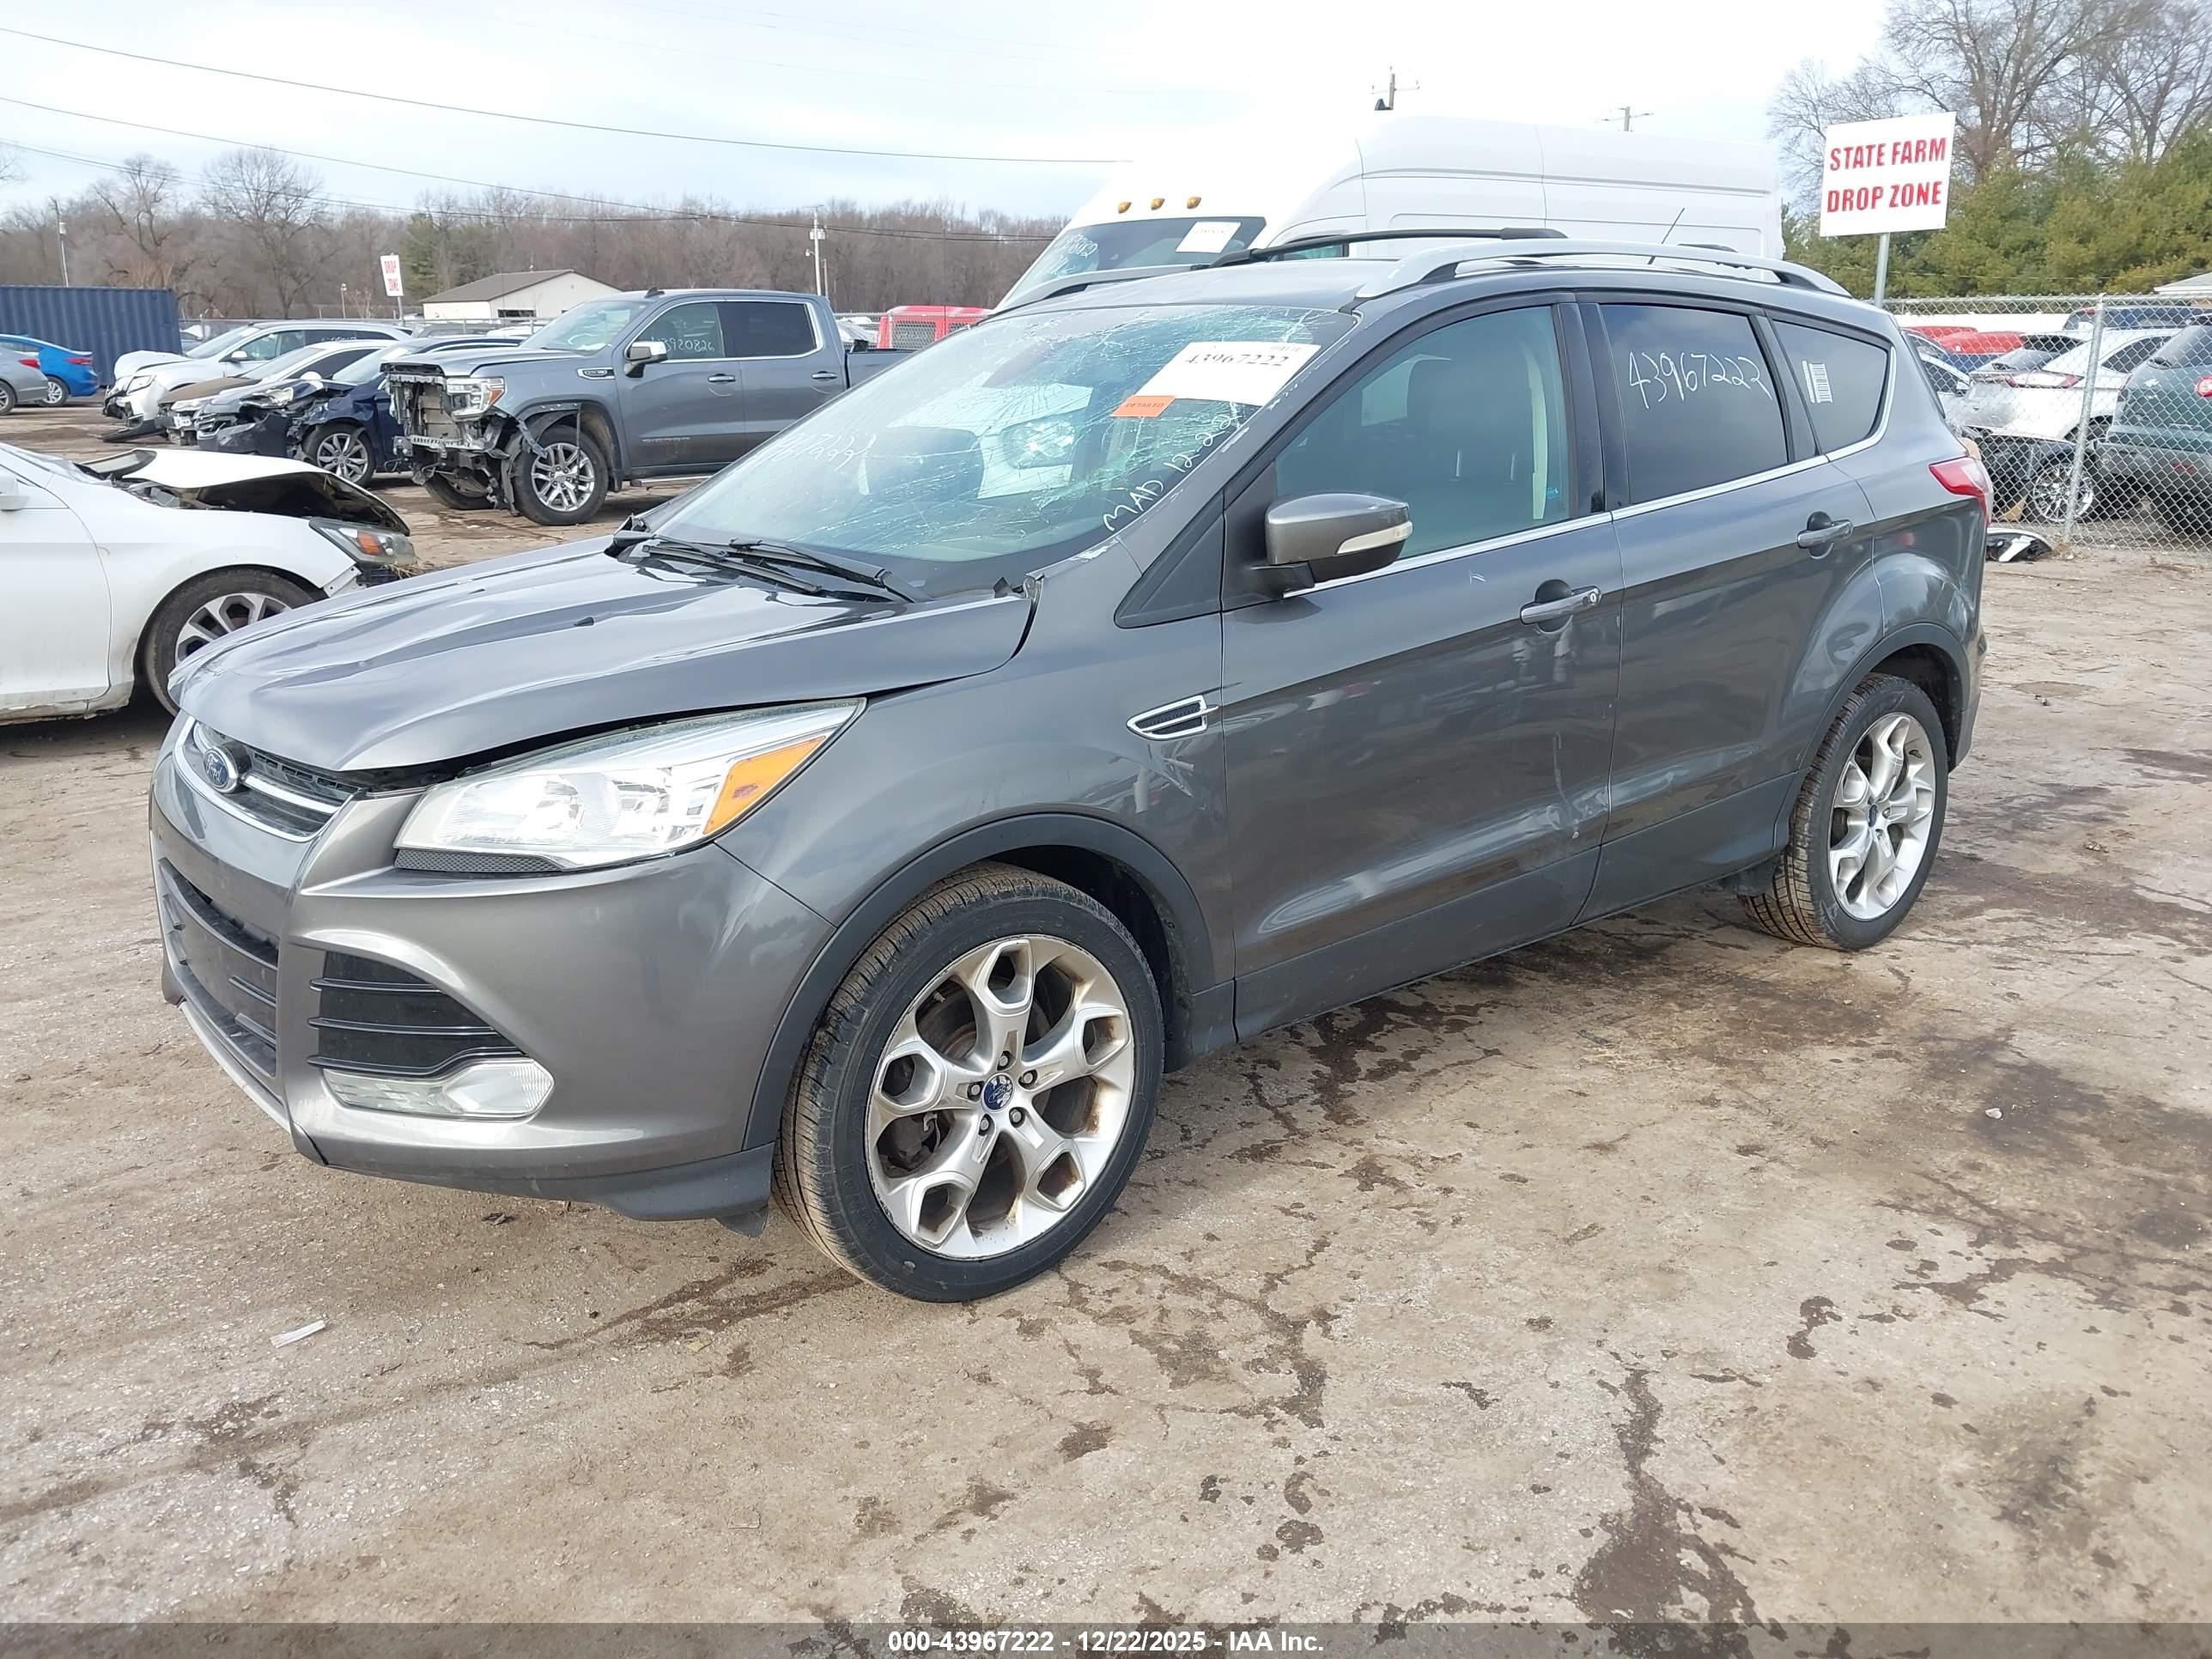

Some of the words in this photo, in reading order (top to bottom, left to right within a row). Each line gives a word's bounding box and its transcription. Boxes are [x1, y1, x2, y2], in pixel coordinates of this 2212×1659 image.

[1830, 143, 1887, 172] STATE
[1891, 137, 1948, 166] FARM
[1827, 185, 1884, 213] DROP
[1888, 181, 1942, 208] ZONE
[1184, 352, 1291, 368] 43967222
[1628, 350, 1773, 410] 43967222
[1103, 479, 1164, 532] MAD
[205, 752, 223, 783] Ford
